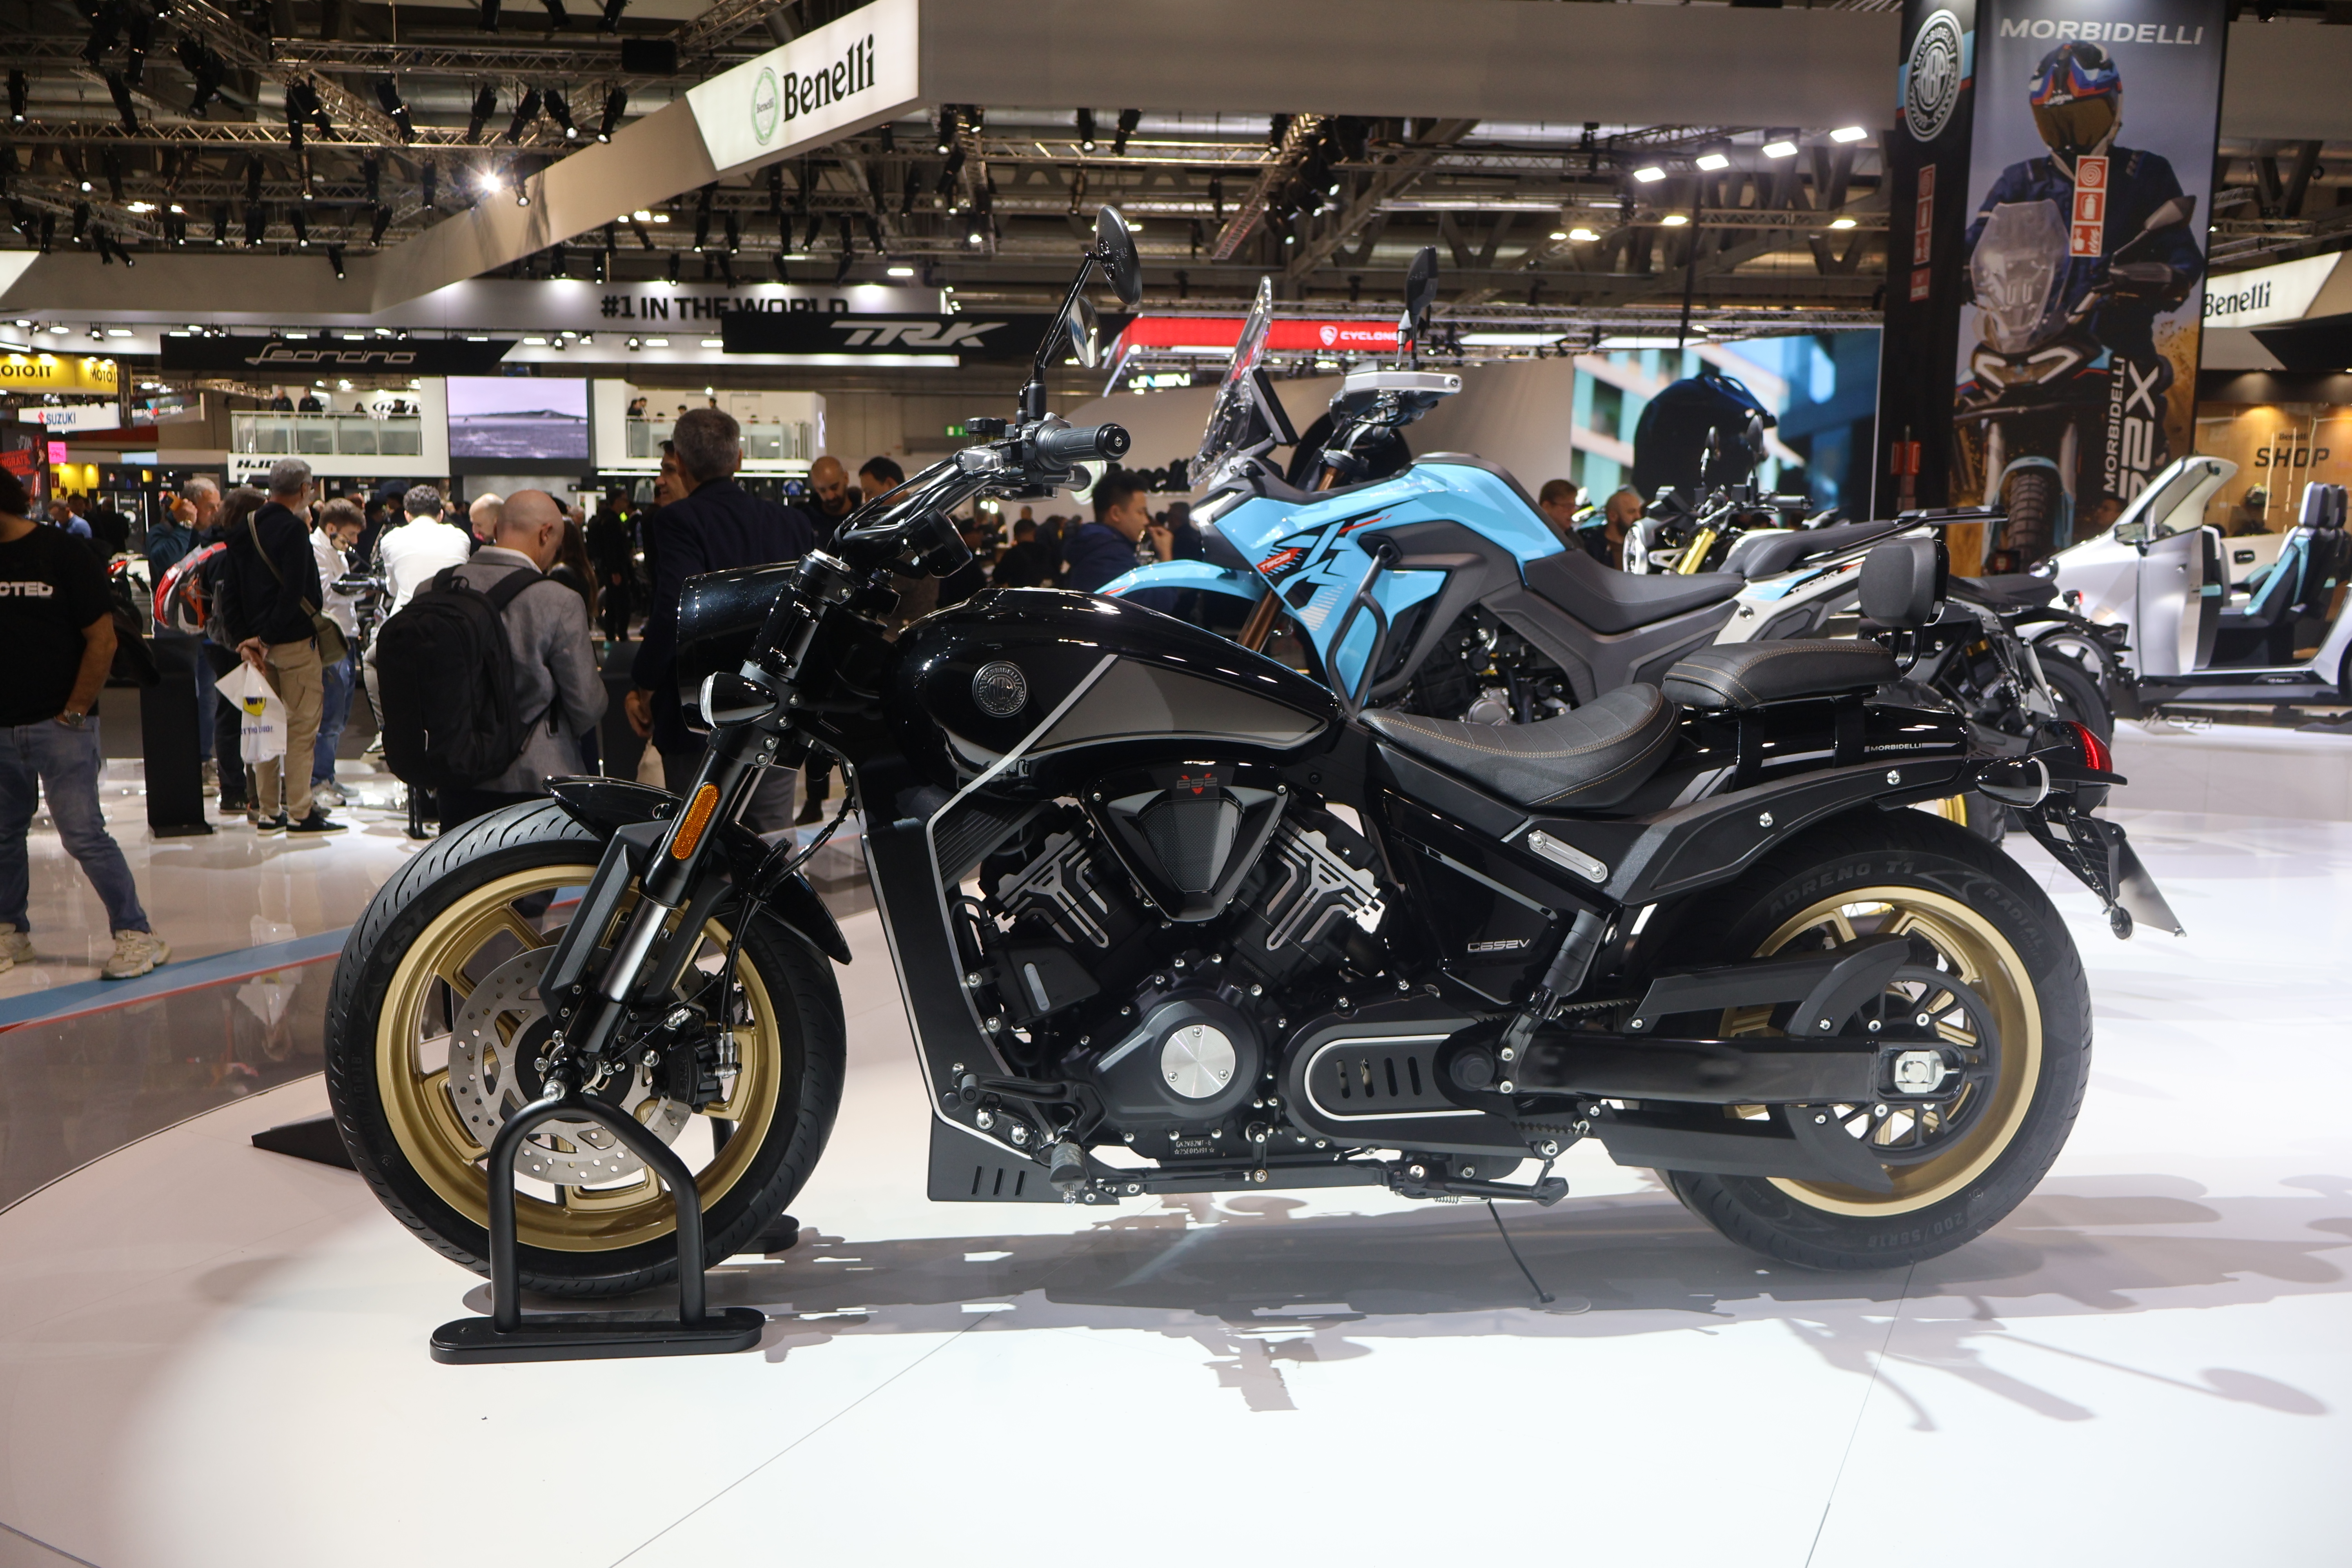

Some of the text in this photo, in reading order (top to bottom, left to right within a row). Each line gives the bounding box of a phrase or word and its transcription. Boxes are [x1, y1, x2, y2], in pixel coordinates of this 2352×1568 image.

[2000, 18, 2203, 45] MORBIDELLI
[784, 34, 875, 122] Benelli
[757, 97, 775, 114] Benelli
[601, 295, 635, 319] #1
[641, 297, 669, 319] IN
[674, 298, 731, 319] THE
[2205, 281, 2271, 317] Benelli
[830, 321, 1009, 347] TRK
[0, 365, 53, 377] OTO.IT
[46, 411, 76, 425] SUZUKI
[2103, 356, 2126, 493] MORBIDELLI
[2254, 447, 2330, 468] SHOP
[981, 667, 1020, 682] MORBIDELLI
[1870, 743, 1921, 751] MORBIDELLI
[1176, 777, 1218, 789] 652
[1768, 860, 1915, 919] ADRENO T1
[1984, 886, 2049, 949] RADIAL
[380, 901, 426, 964] CST
[1468, 939, 1530, 952] C652V
